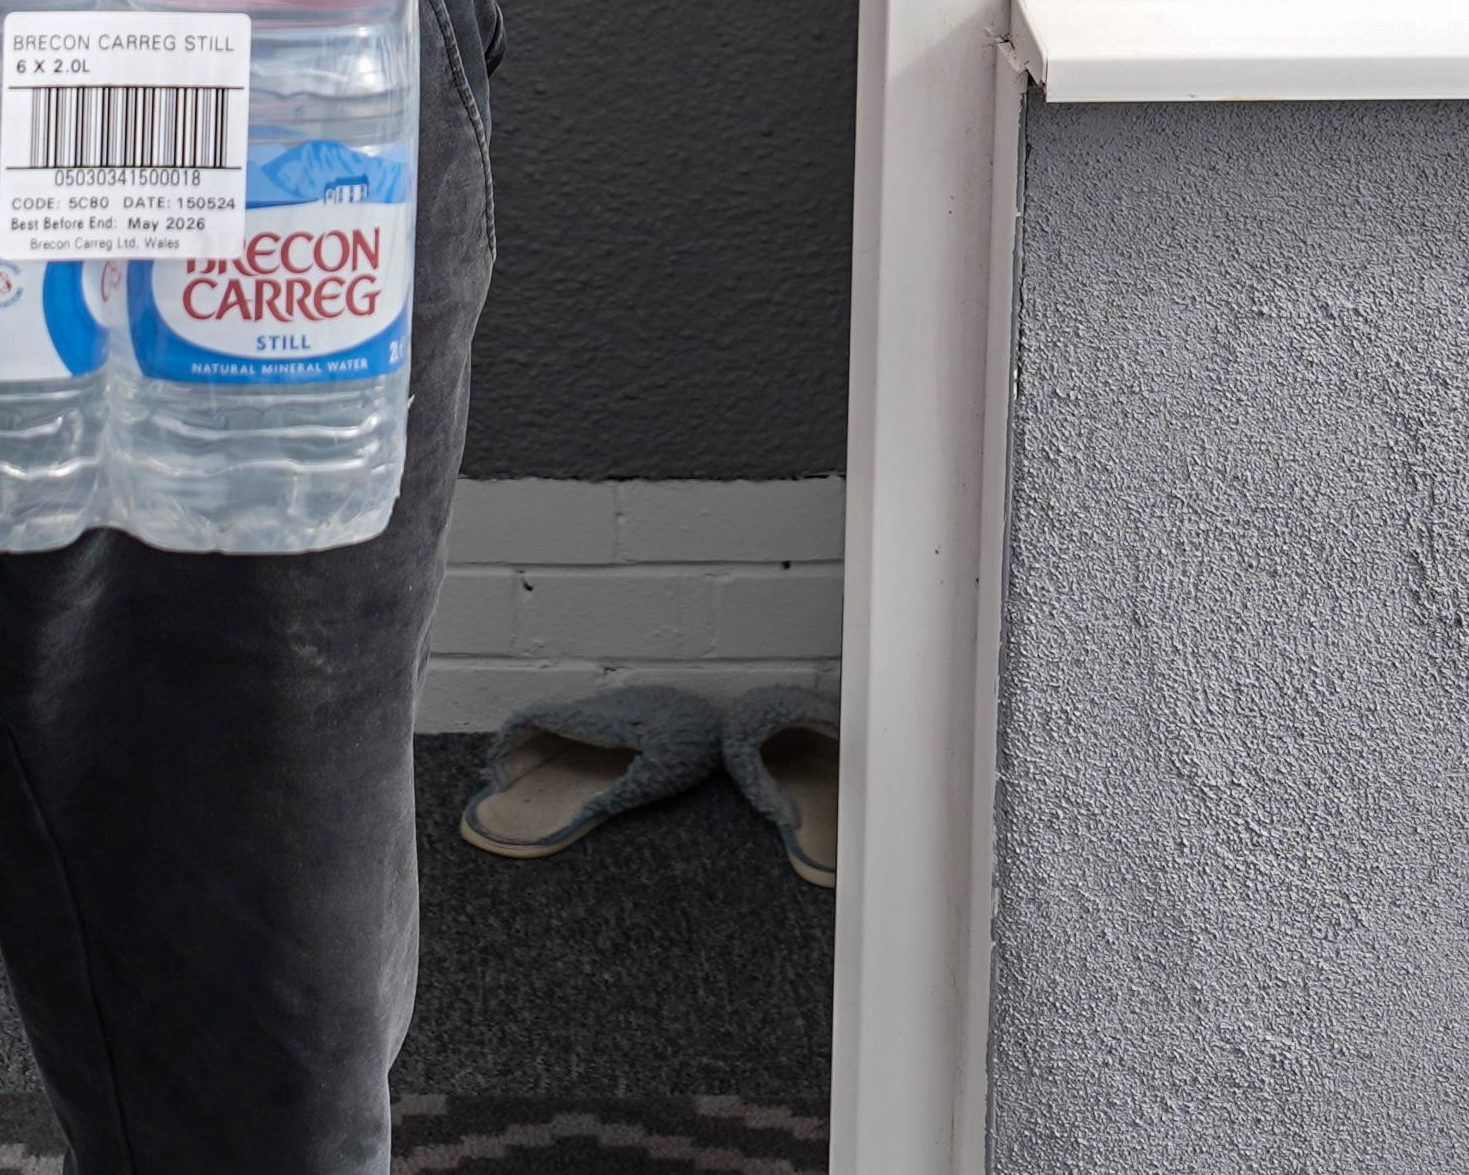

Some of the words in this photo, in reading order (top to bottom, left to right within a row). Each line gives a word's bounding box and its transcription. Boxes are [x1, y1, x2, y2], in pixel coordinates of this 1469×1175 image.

[13, 34, 90, 51] BRECON
[98, 34, 176, 51] CARREG
[184, 35, 234, 52] STILL
[16, 59, 27, 74] 6
[33, 59, 45, 74] X
[53, 59, 91, 74] 2.0L
[54, 169, 202, 187] 05030341500018
[11, 197, 61, 210] CODE:
[68, 197, 109, 210] 5C80
[123, 197, 171, 210] DATE:
[177, 197, 237, 210] 150524
[10, 217, 39, 231] Best
[43, 217, 84, 231] Before
[89, 217, 117, 230] End:
[128, 217, 159, 232] May
[166, 218, 206, 231] 2026
[30, 238, 71, 250] Brecon
[75, 238, 113, 252] Carreg
[144, 238, 181, 250] Wales
[183, 274, 381, 322] CARREG
[256, 335, 311, 351] STILL
[191, 362, 257, 375] NATURAL
[261, 362, 321, 374] MINERAL
[327, 358, 368, 371] WATER
